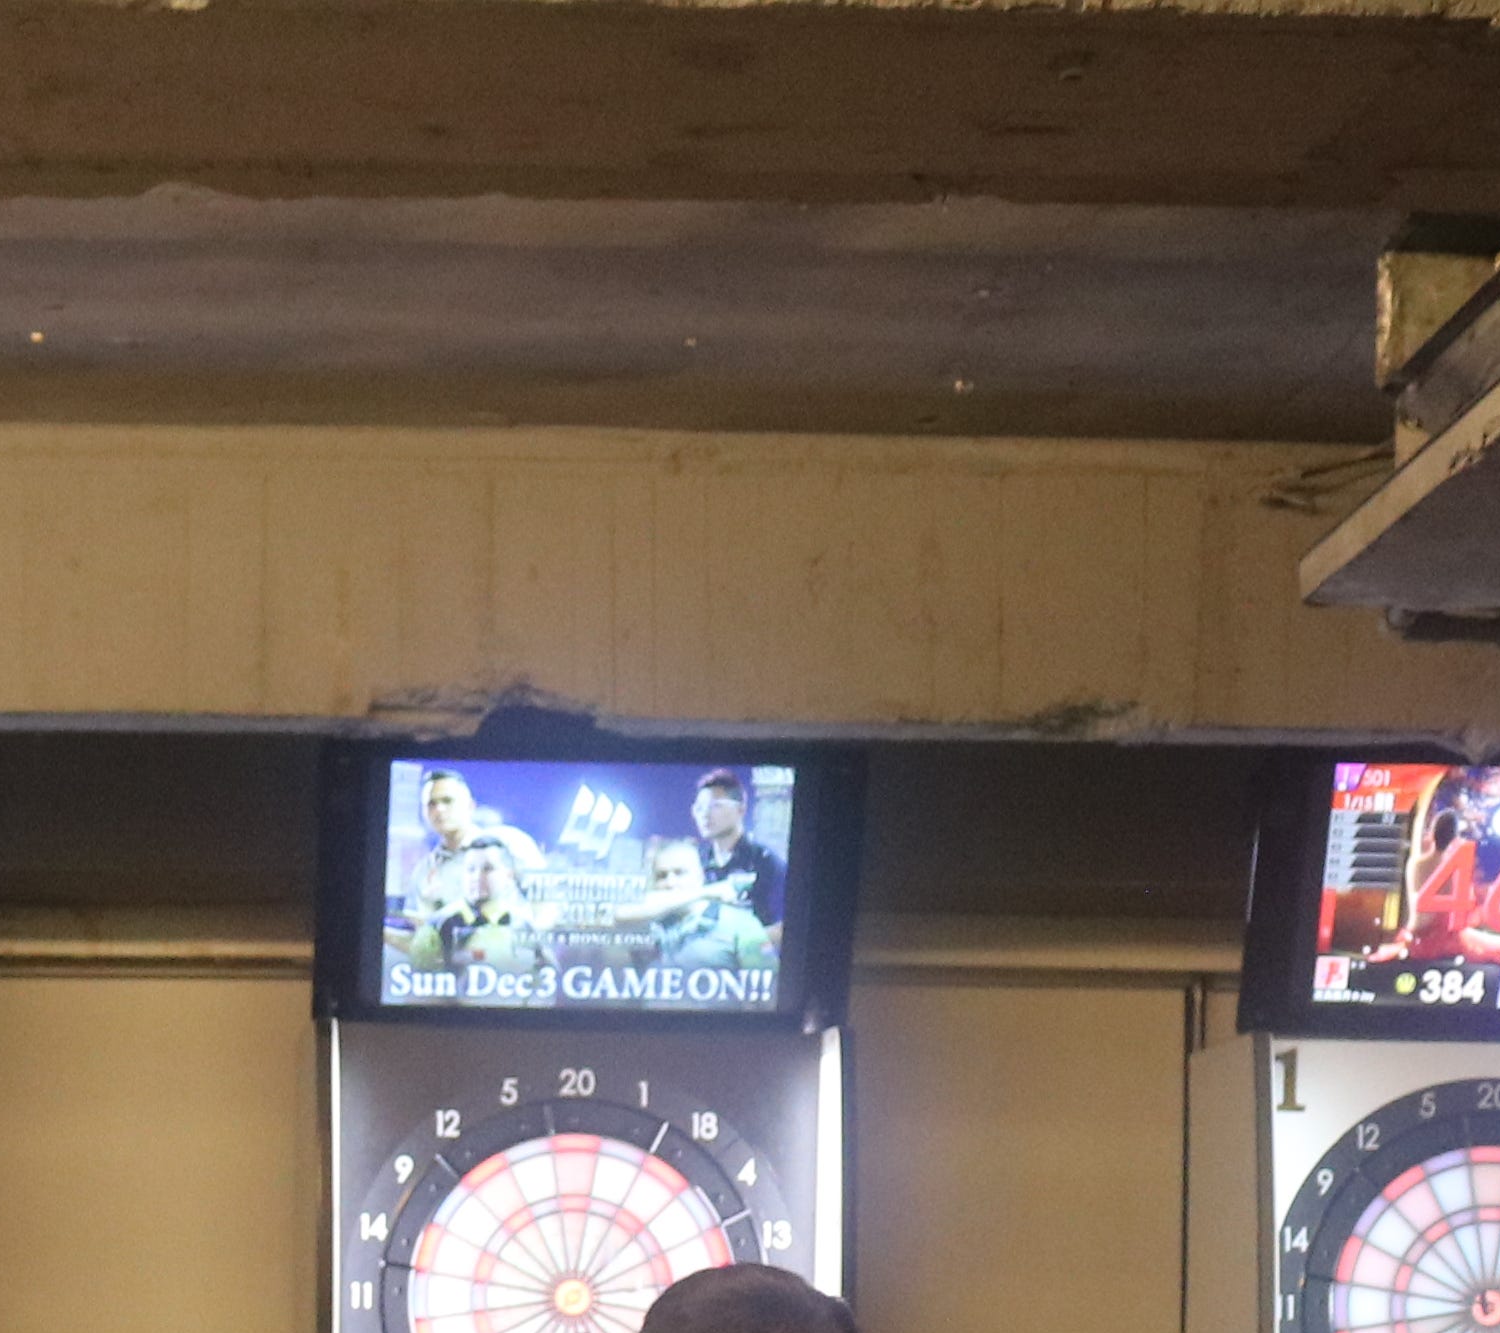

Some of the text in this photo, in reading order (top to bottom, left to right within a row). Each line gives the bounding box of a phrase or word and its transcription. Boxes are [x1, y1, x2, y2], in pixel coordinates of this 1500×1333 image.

[390, 963, 773, 1002] Sun Dec 3 GAME ON!!
[1419, 969, 1486, 1005] 384
[501, 1079, 517, 1104] 5
[561, 1069, 595, 1095] 20
[640, 1082, 647, 1106] 1
[1420, 1093, 1436, 1118] 5
[437, 1110, 459, 1137] 12
[694, 1113, 717, 1139] 18
[1358, 1125, 1379, 1149] 12
[395, 1156, 413, 1183] 9
[738, 1159, 757, 1186] 4
[1317, 1170, 1333, 1195] 9
[361, 1213, 387, 1240] 14
[764, 1221, 791, 1249] 13
[1285, 1227, 1308, 1252] 14
[351, 1282, 372, 1309] 11
